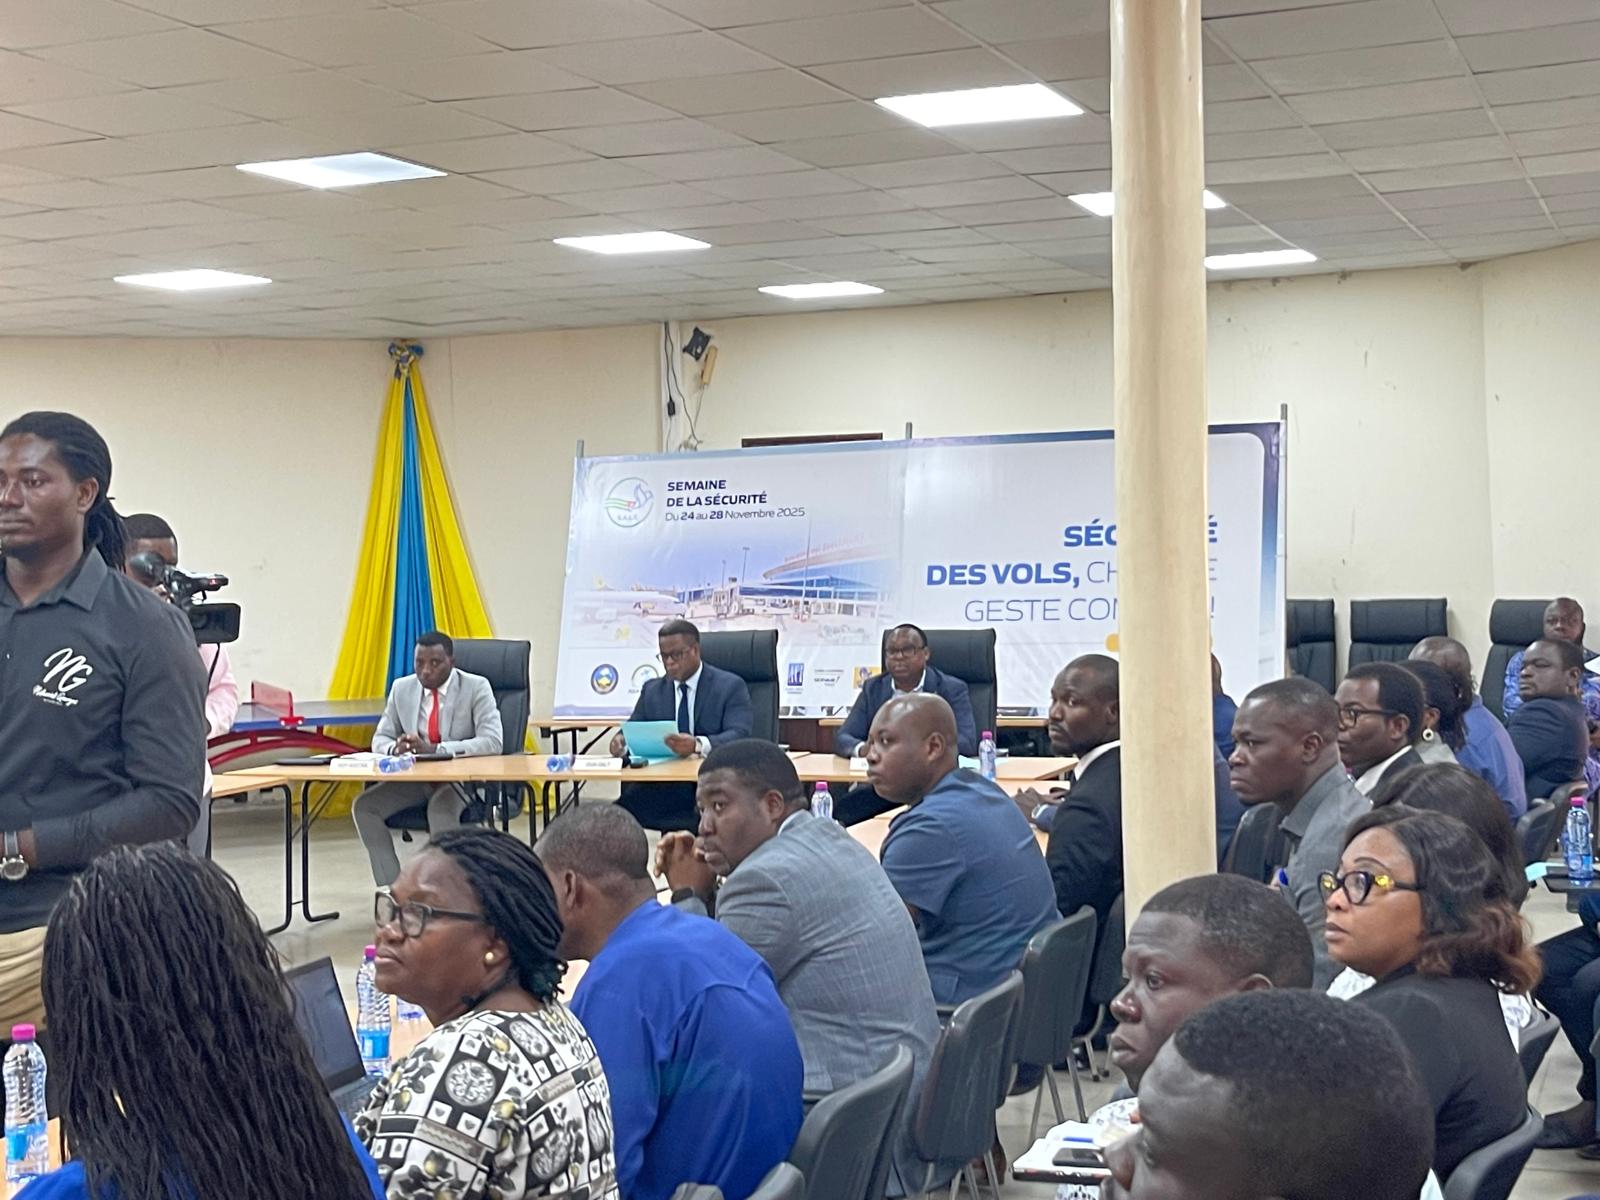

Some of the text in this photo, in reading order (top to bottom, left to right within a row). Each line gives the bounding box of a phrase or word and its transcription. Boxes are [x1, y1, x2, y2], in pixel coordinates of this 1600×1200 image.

[667, 480, 727, 492] SEMAINE
[666, 490, 767, 507] DE LA SÉCURITÉ
[665, 507, 806, 521] Du 24 au 28 Novembre 2025
[927, 564, 987, 586] DES
[992, 562, 1080, 589] VOLS,
[964, 598, 1062, 622] GESTE
